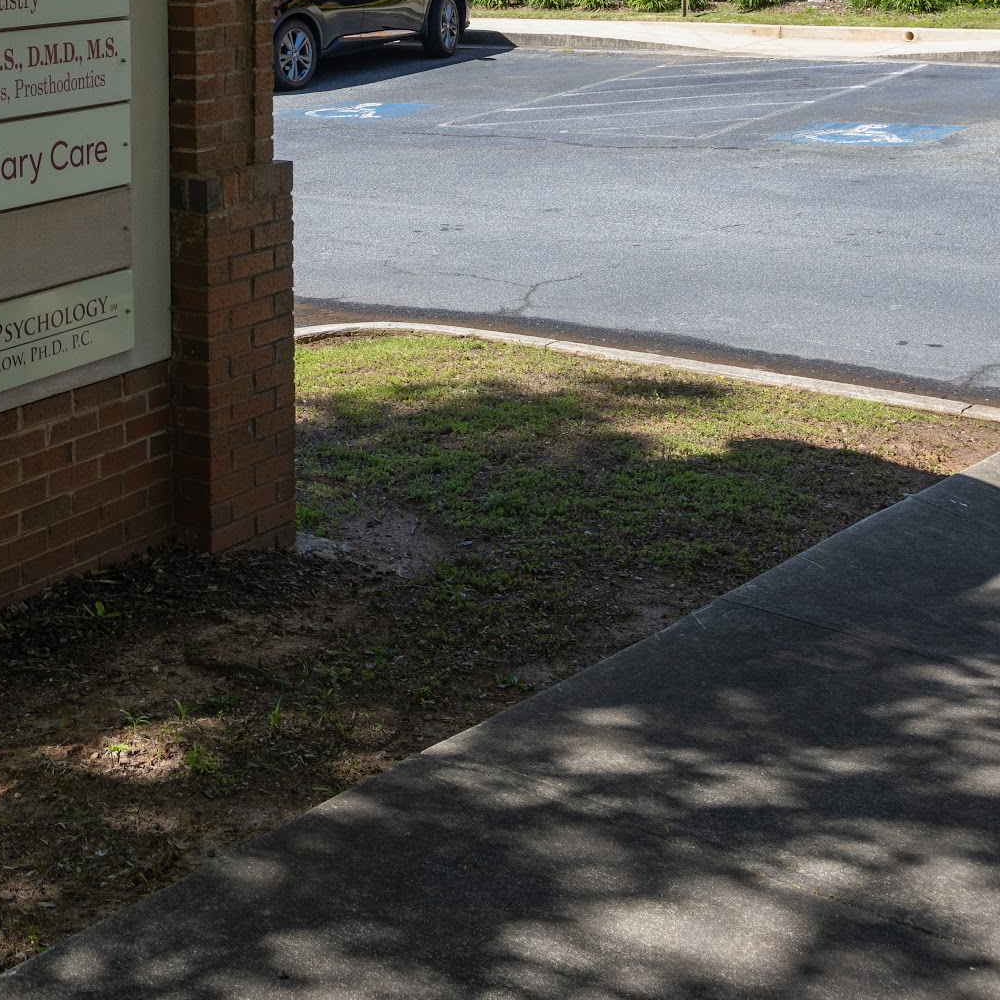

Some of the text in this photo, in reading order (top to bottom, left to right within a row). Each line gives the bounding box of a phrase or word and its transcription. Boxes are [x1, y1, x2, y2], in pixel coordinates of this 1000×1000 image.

[27, 42, 82, 67] D.M.D.,
[87, 37, 117, 60] M.S.
[15, 72, 105, 98] Prosthodontics
[51, 141, 107, 170] Care
